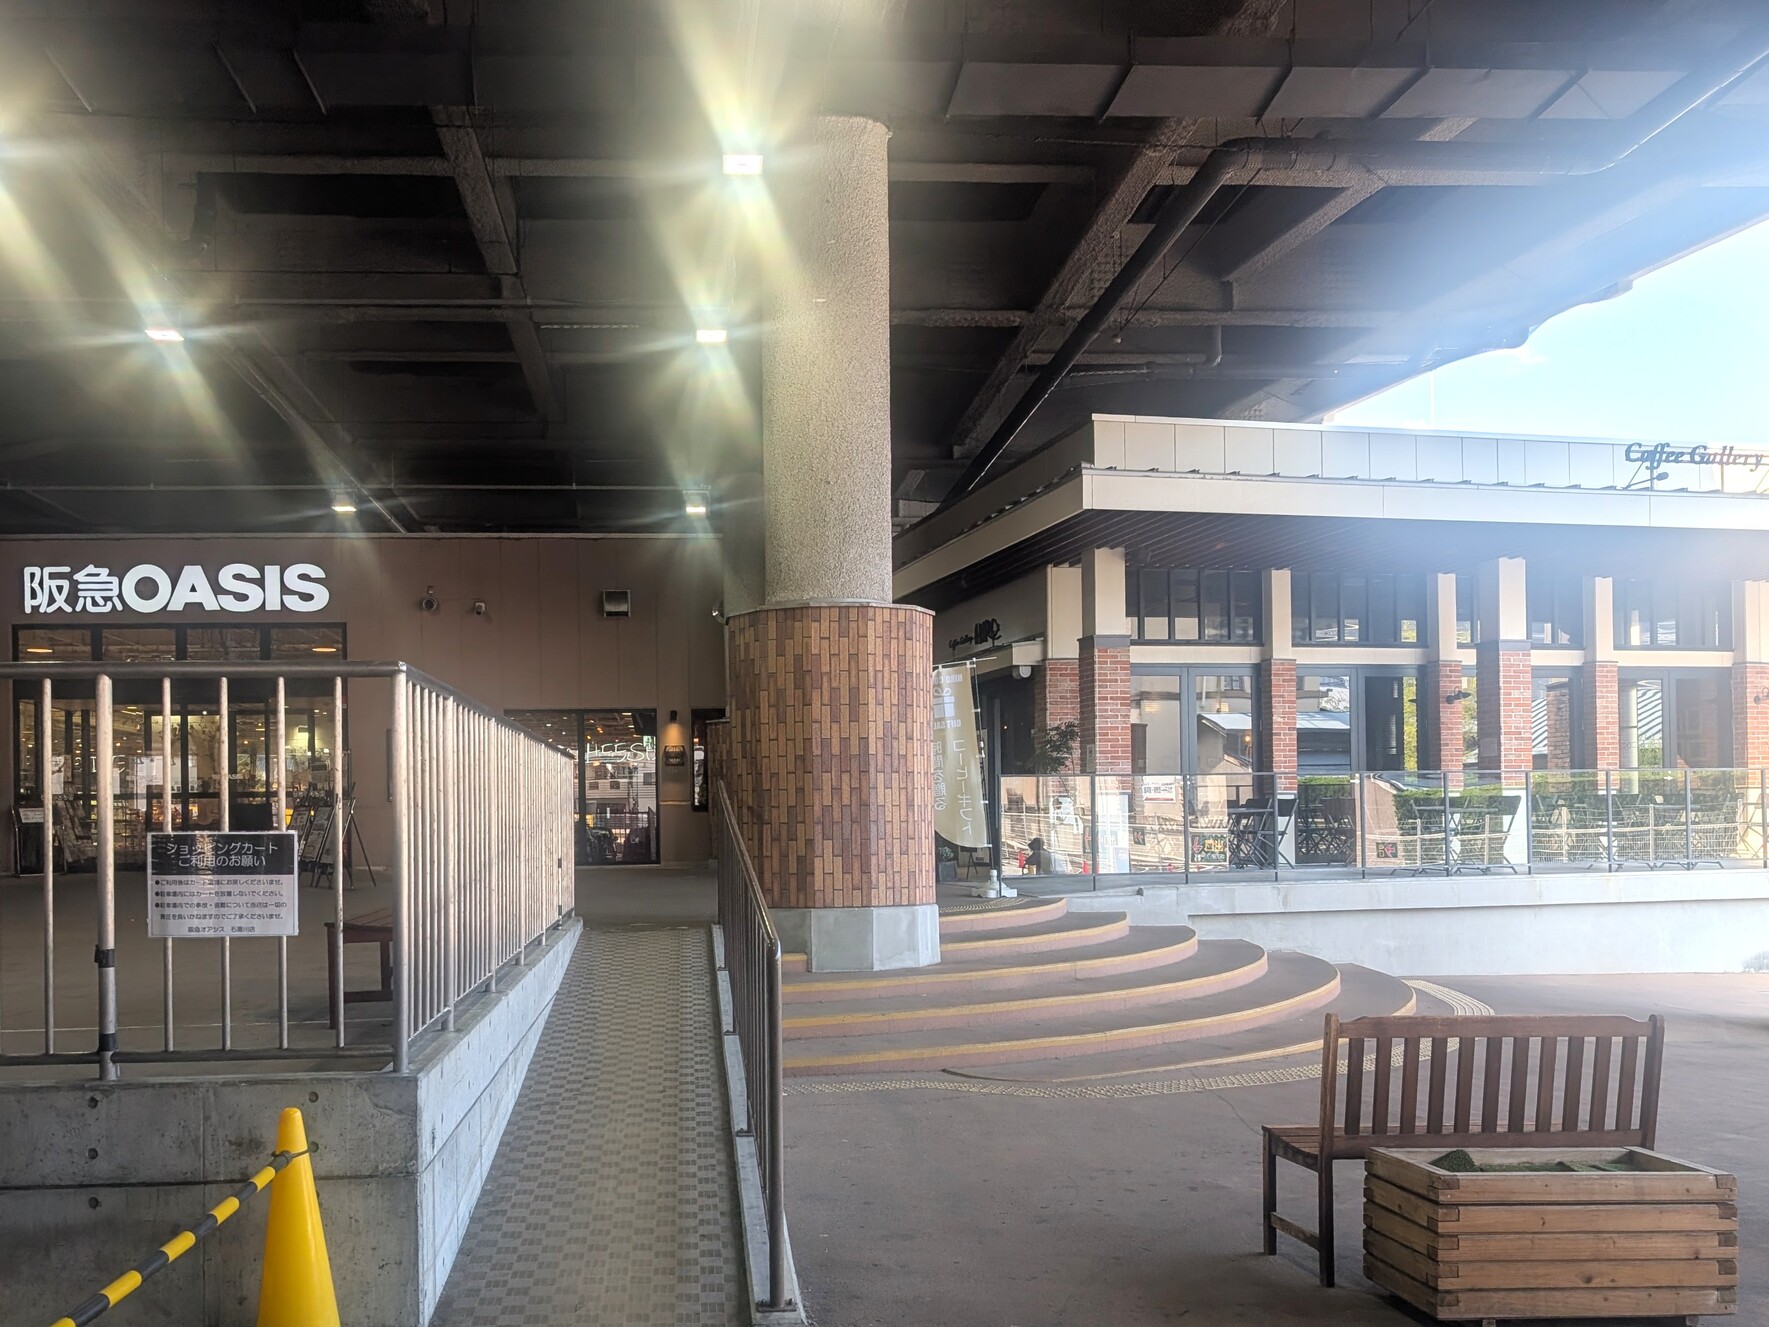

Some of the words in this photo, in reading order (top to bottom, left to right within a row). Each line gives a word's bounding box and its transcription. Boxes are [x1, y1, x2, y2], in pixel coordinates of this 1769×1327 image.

[1625, 442, 1685, 470] Coffee
[1690, 445, 1764, 472] Gallery
[23, 563, 330, 614] 阪急OASIS
[166, 842, 278, 855] ショッピングカート
[178, 855, 266, 867] ご利用のお願い
